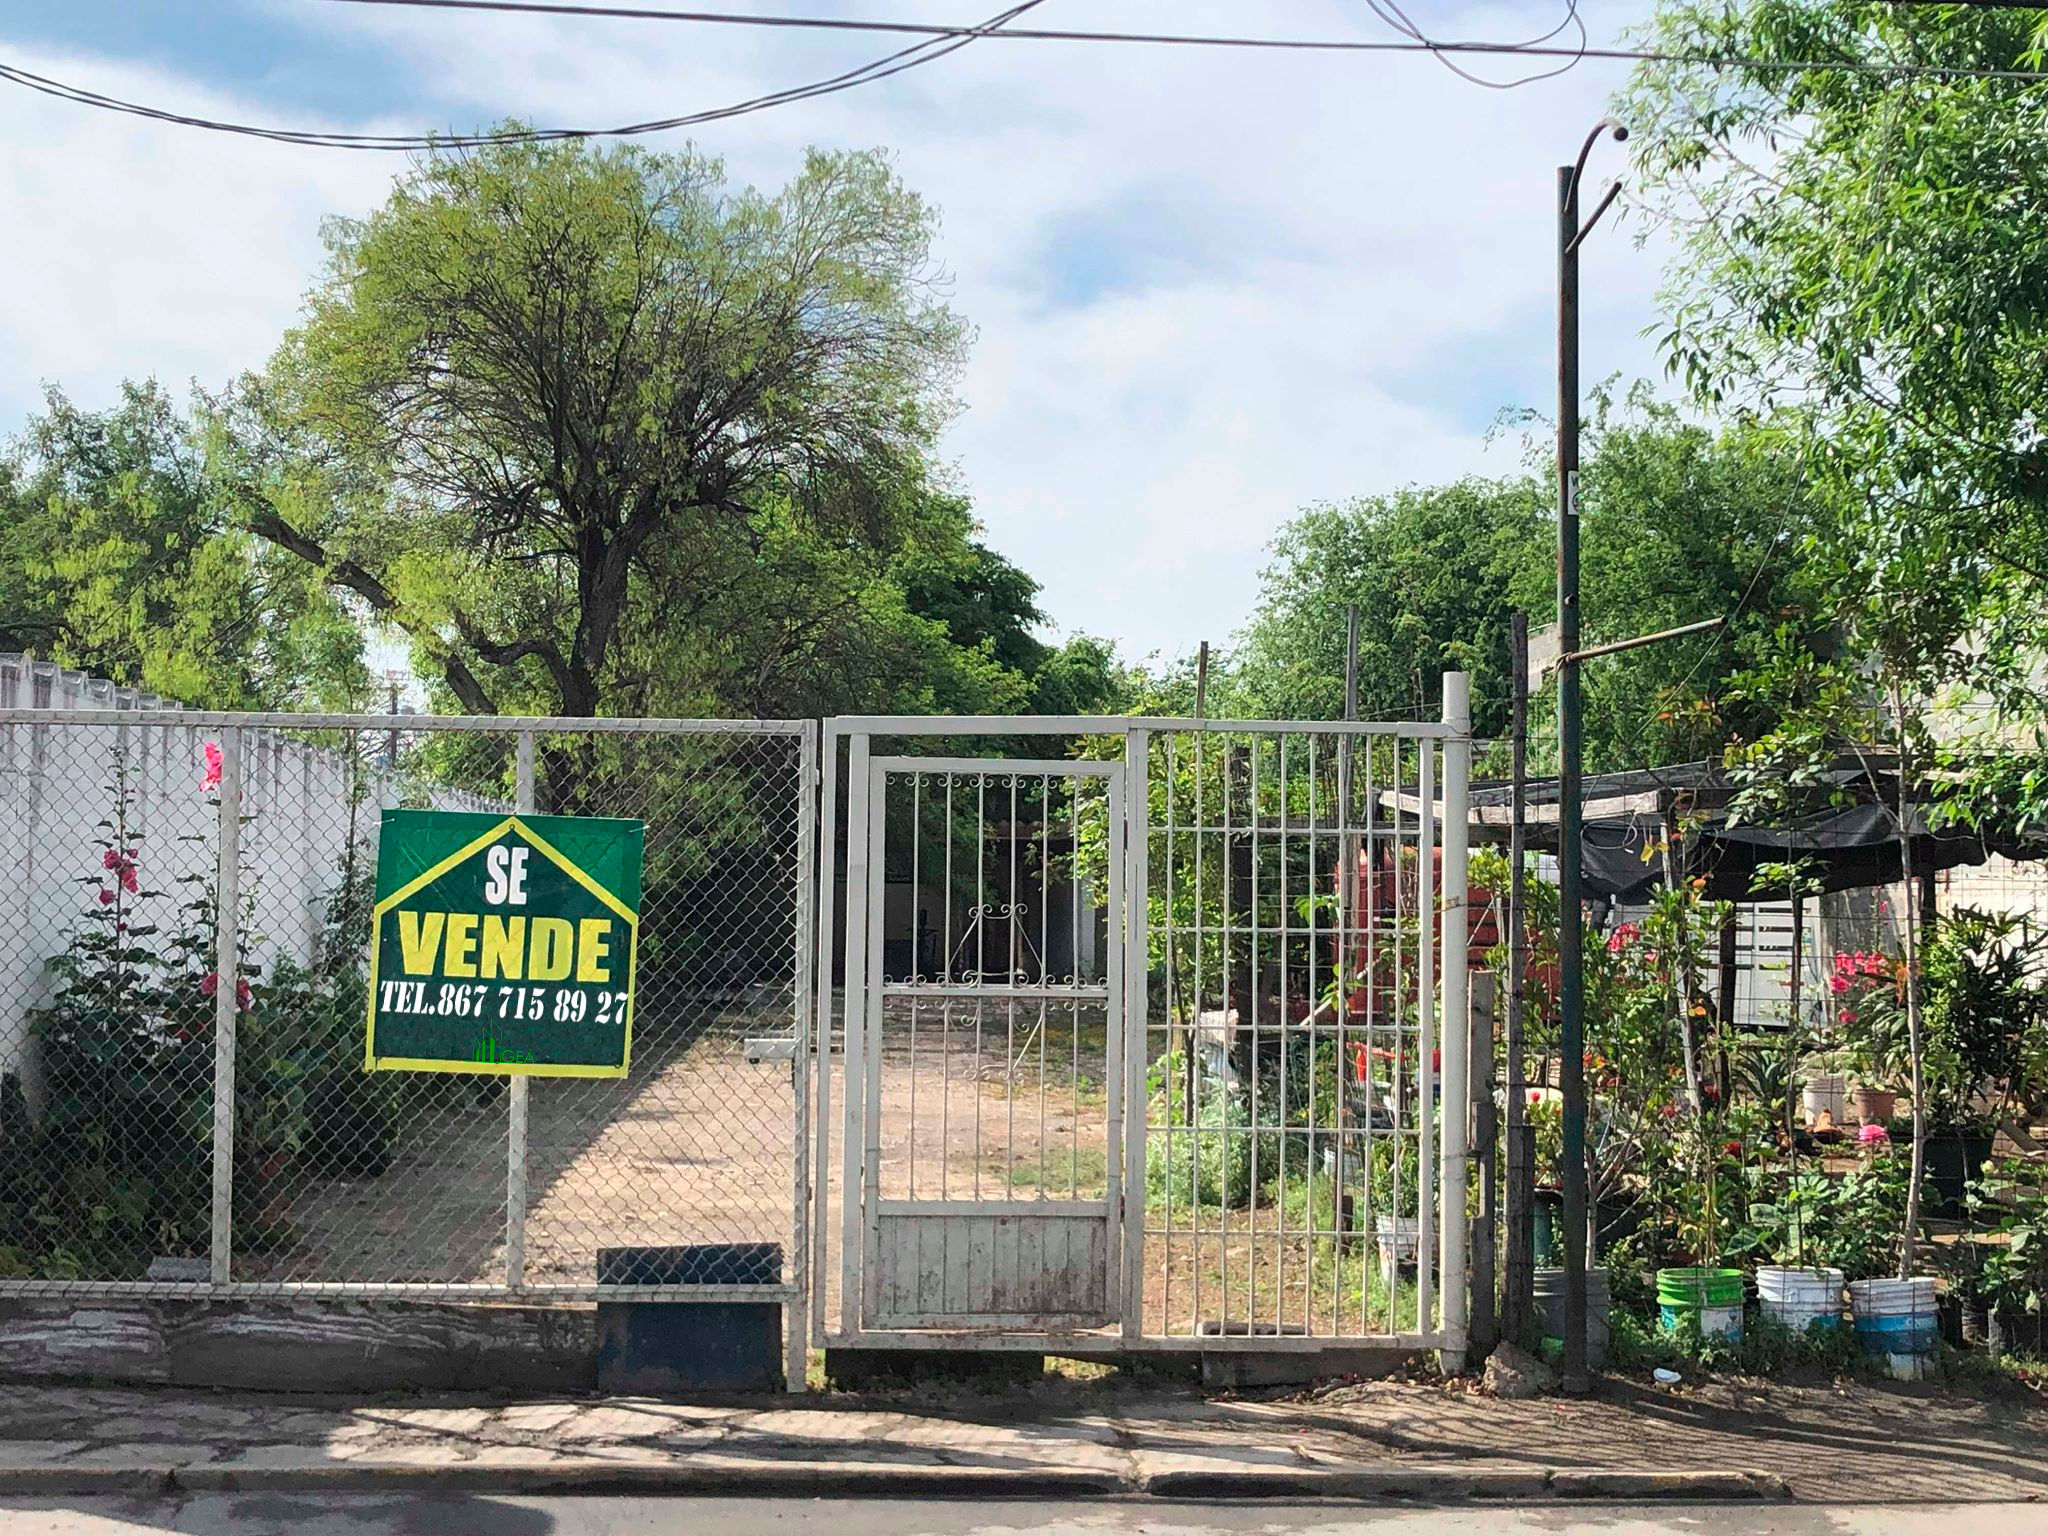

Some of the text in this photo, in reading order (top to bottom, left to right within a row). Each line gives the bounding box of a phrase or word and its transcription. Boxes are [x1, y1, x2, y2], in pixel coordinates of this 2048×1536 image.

[485, 844, 529, 905] SE
[398, 910, 611, 982] VENDE
[498, 986, 545, 1020] 715
[553, 989, 586, 1022] 89
[595, 991, 628, 1024] 27
